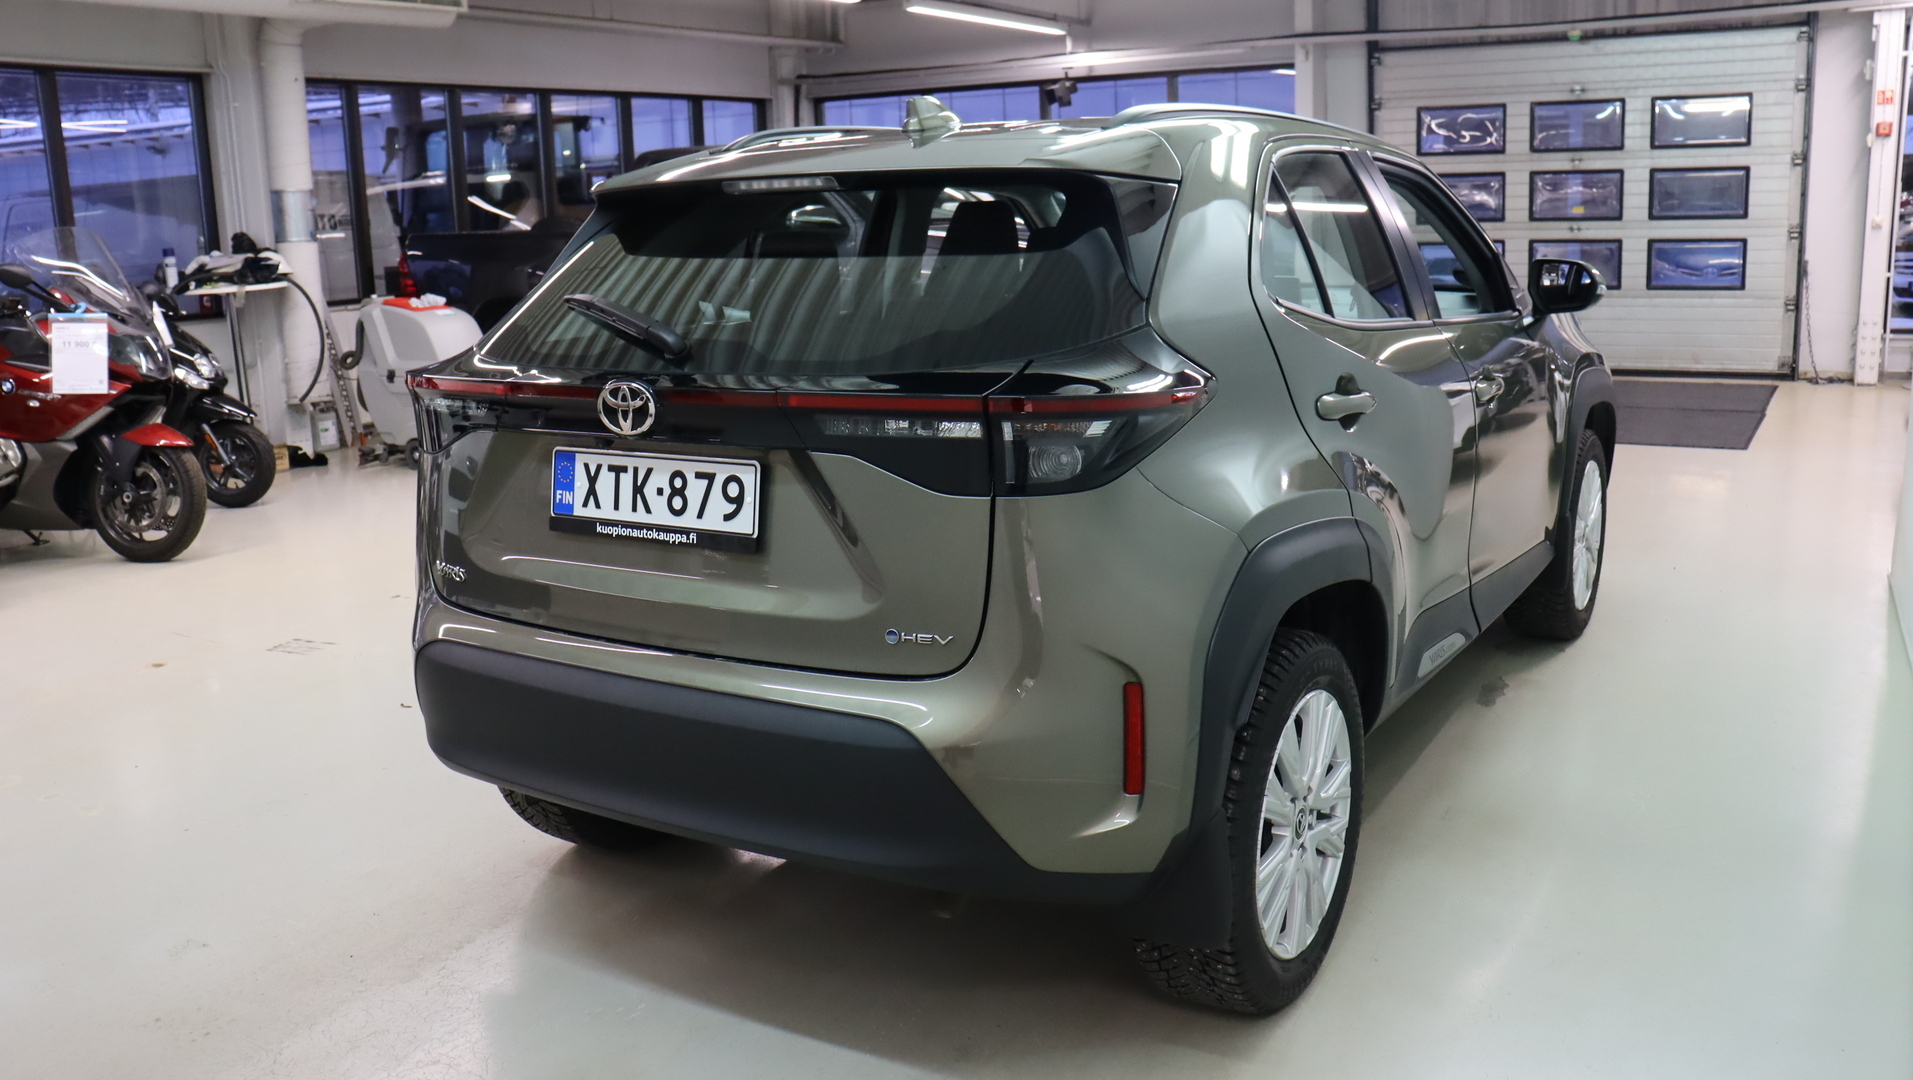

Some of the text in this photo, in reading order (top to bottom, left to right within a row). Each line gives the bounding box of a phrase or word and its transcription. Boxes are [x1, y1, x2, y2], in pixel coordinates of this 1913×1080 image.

[62, 340, 90, 348] 11 900
[556, 490, 573, 504] FIN
[581, 462, 745, 522] XTK-879
[596, 522, 697, 544] kuopionautokauppa.fi
[901, 632, 954, 646] HEV
